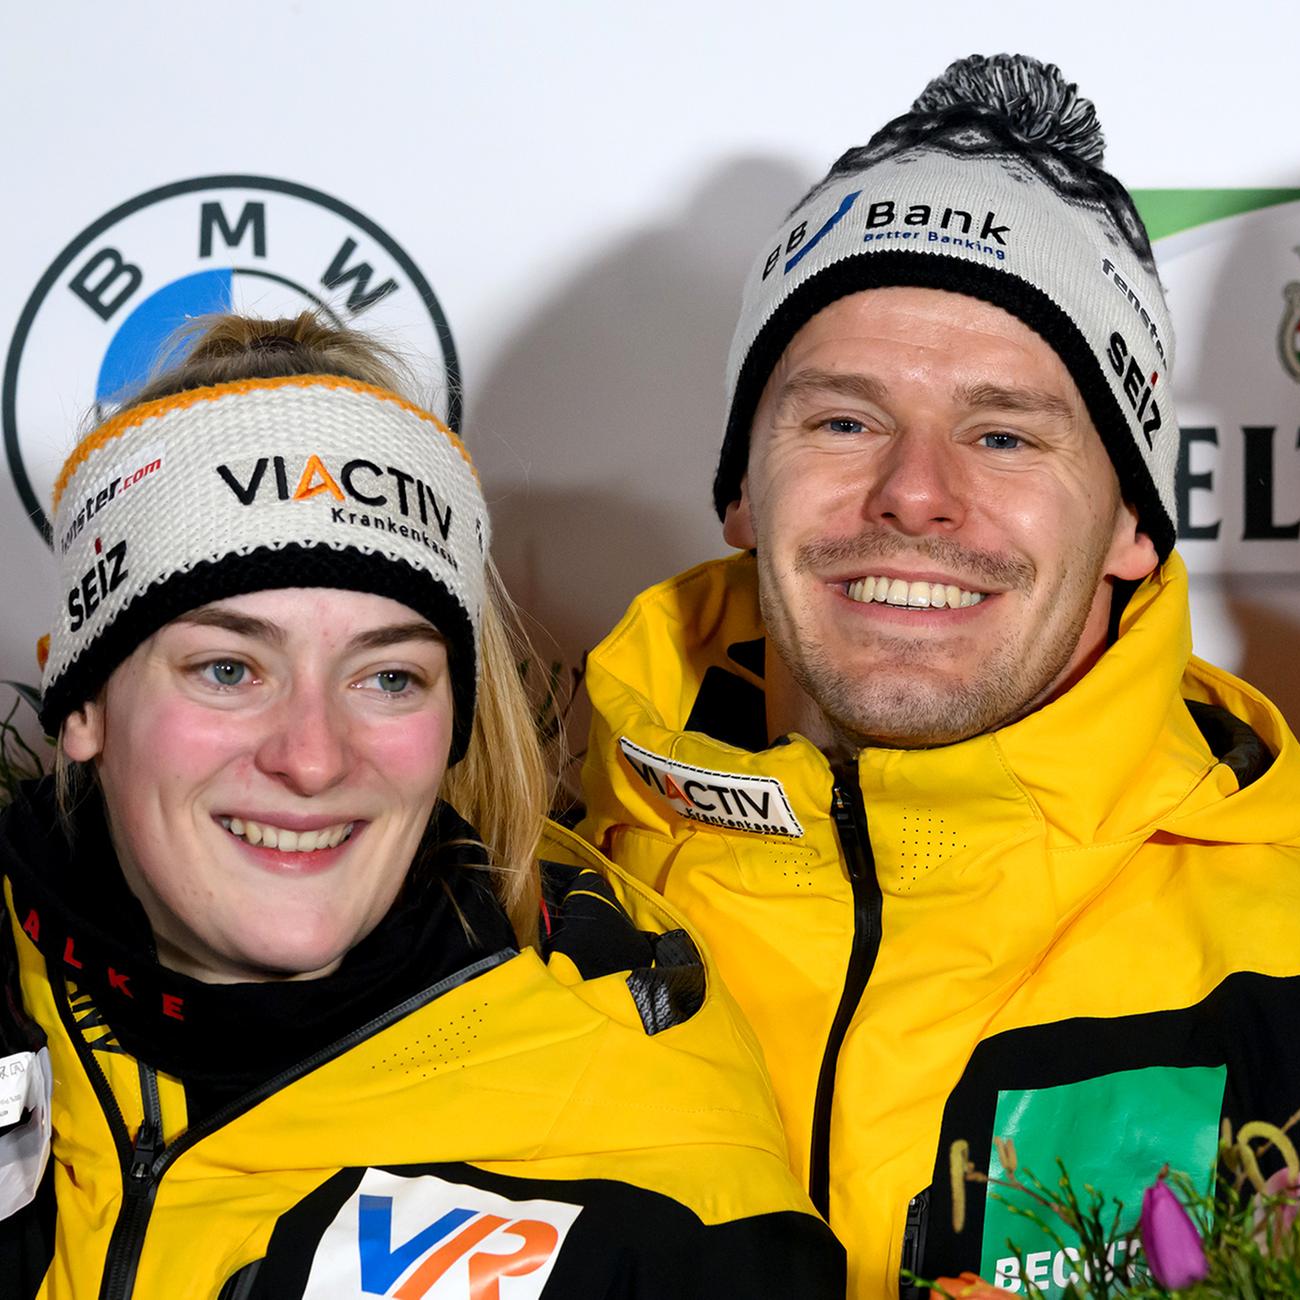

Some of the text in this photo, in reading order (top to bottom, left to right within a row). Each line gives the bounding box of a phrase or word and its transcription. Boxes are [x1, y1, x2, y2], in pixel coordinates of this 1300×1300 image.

[68, 201, 398, 322] BMW
[863, 231, 1005, 260] Better Banking
[866, 201, 1010, 246] Bank
[217, 454, 452, 541] VIACTIV
[624, 753, 770, 819] VIACTIV
[23, 909, 185, 1021] ALKE
[358, 1194, 559, 1300] VR
